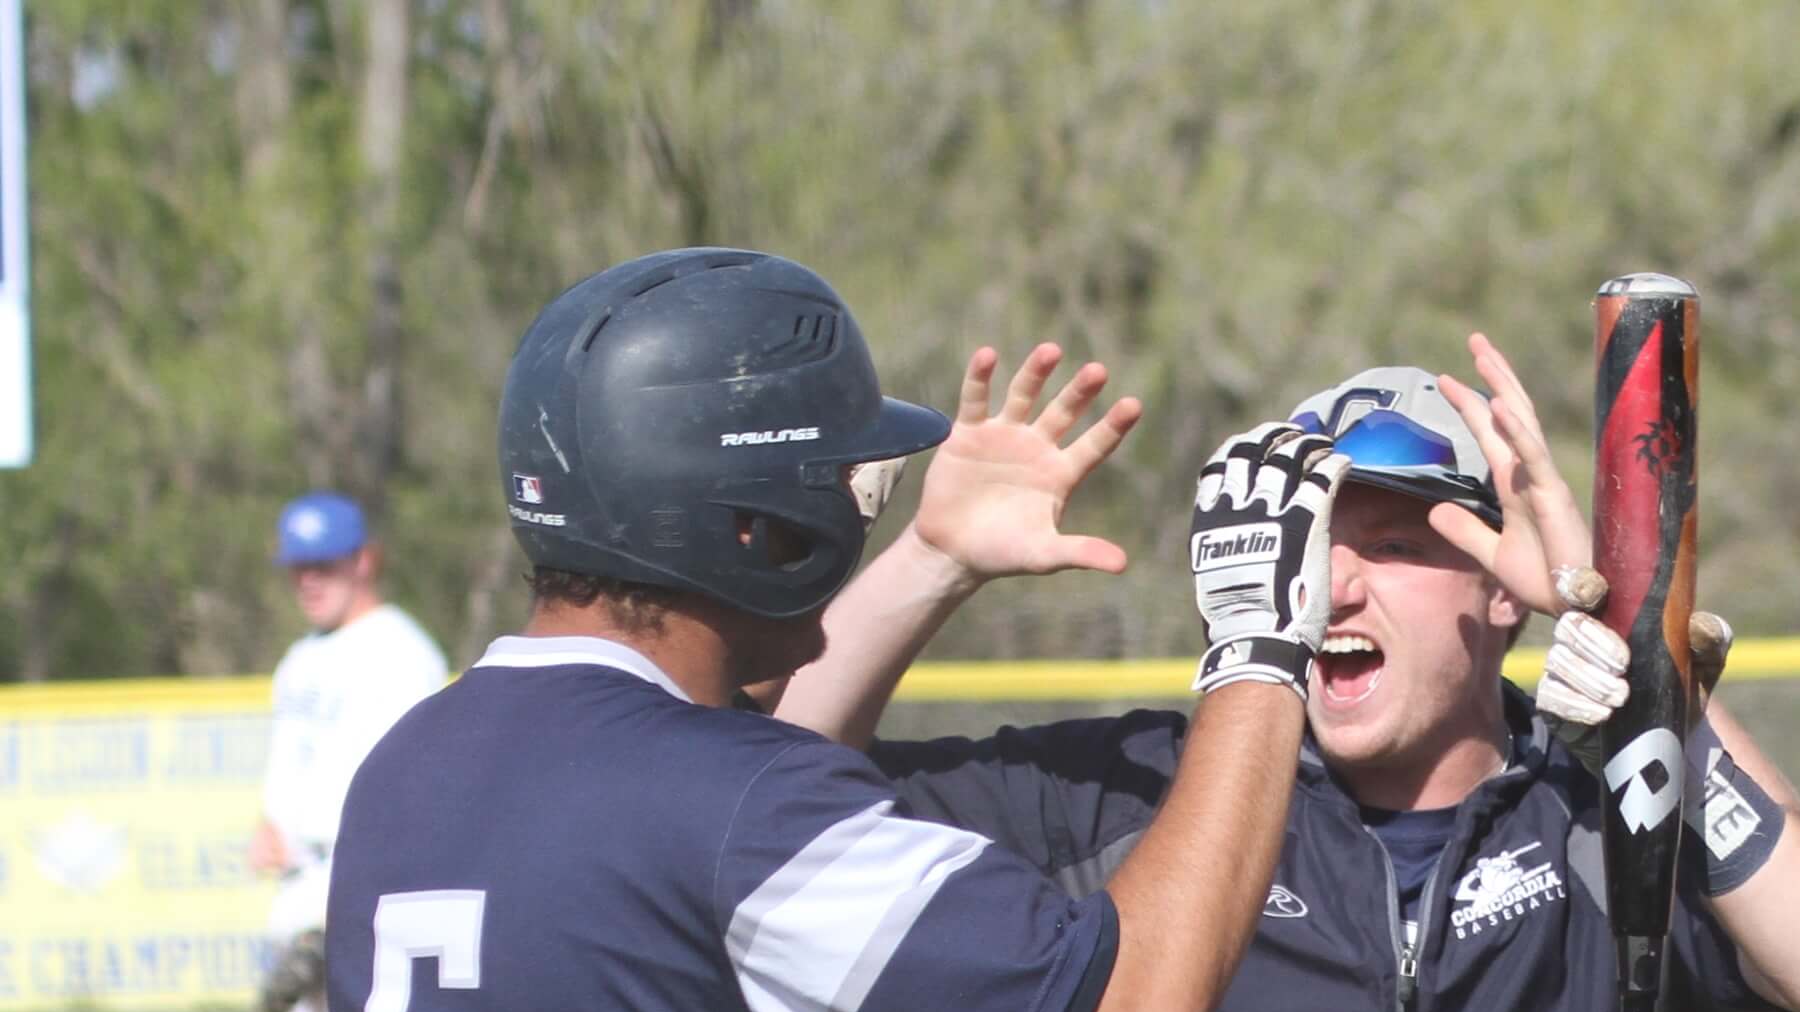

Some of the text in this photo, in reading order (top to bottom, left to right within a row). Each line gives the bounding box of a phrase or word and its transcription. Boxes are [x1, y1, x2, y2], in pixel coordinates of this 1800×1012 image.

[719, 426, 820, 447] RAWLINGS
[1195, 531, 1278, 569] Franklin
[1456, 886, 1566, 940] BASEBALL
